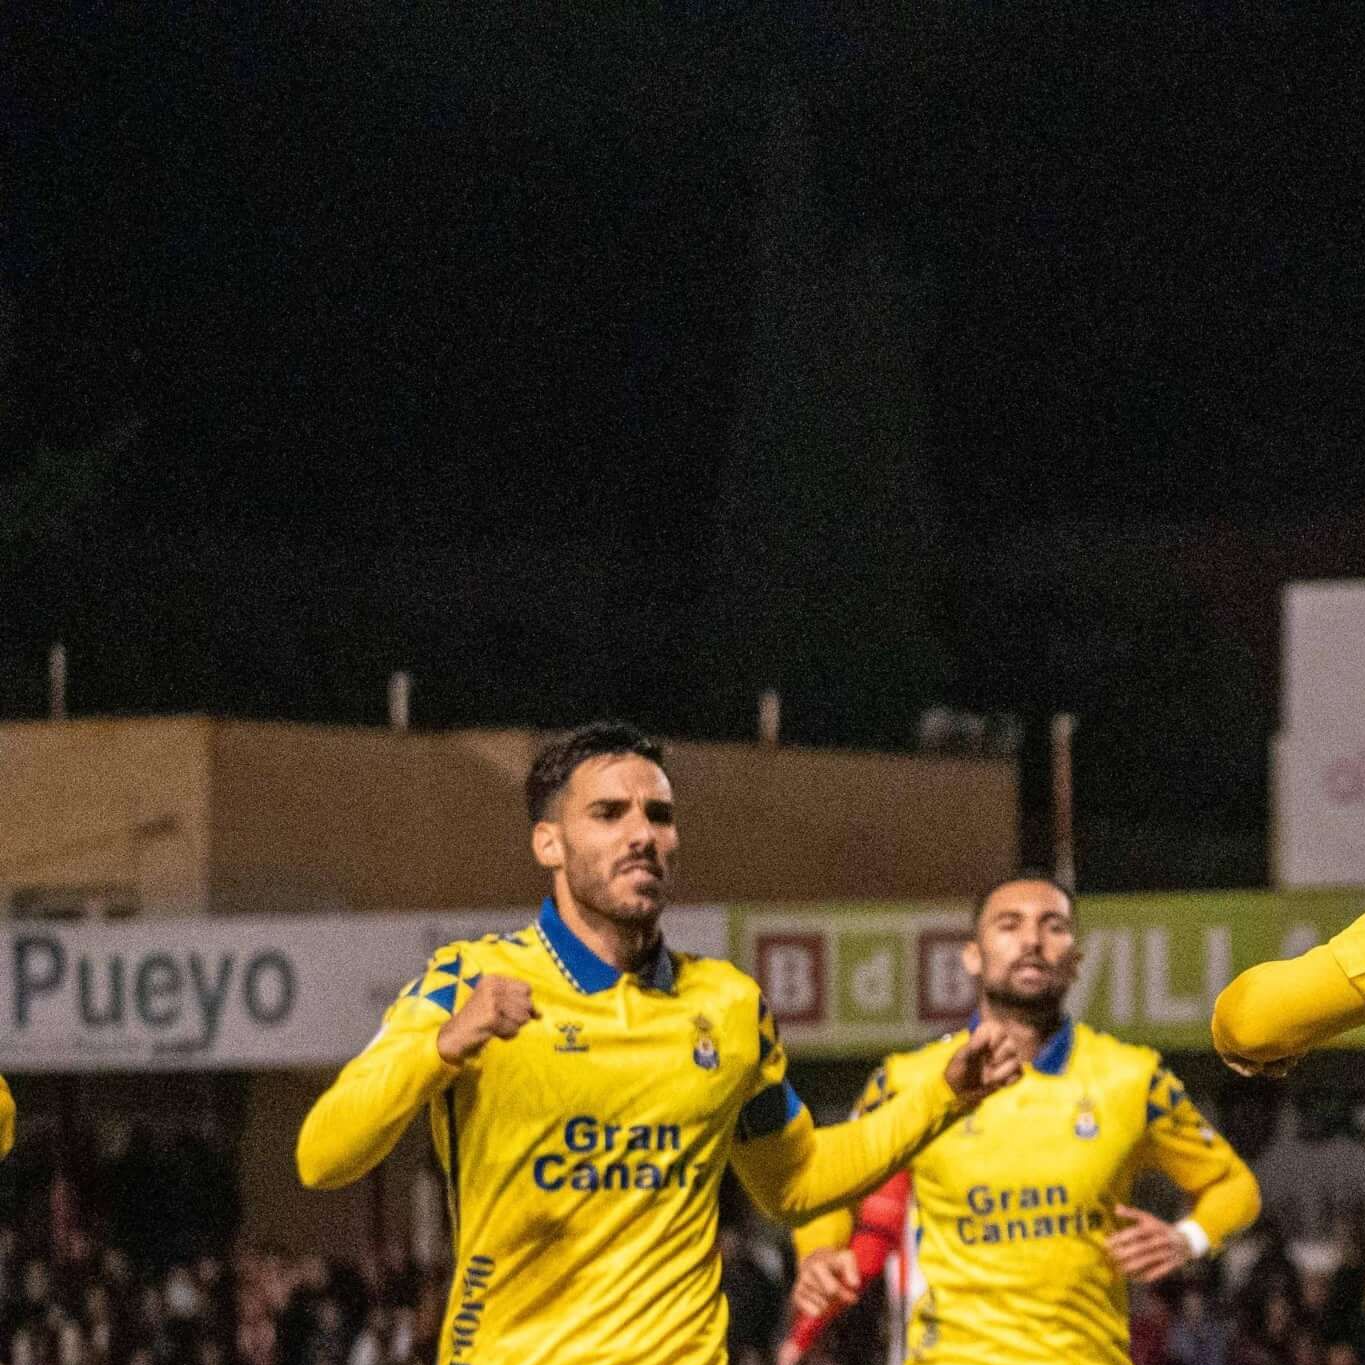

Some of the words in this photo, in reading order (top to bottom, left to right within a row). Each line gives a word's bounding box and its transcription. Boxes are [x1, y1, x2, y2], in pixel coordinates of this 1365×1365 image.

[13, 936, 294, 1052] Pueyo
[564, 1115, 681, 1152] Gran
[967, 1184, 1067, 1216] Gran
